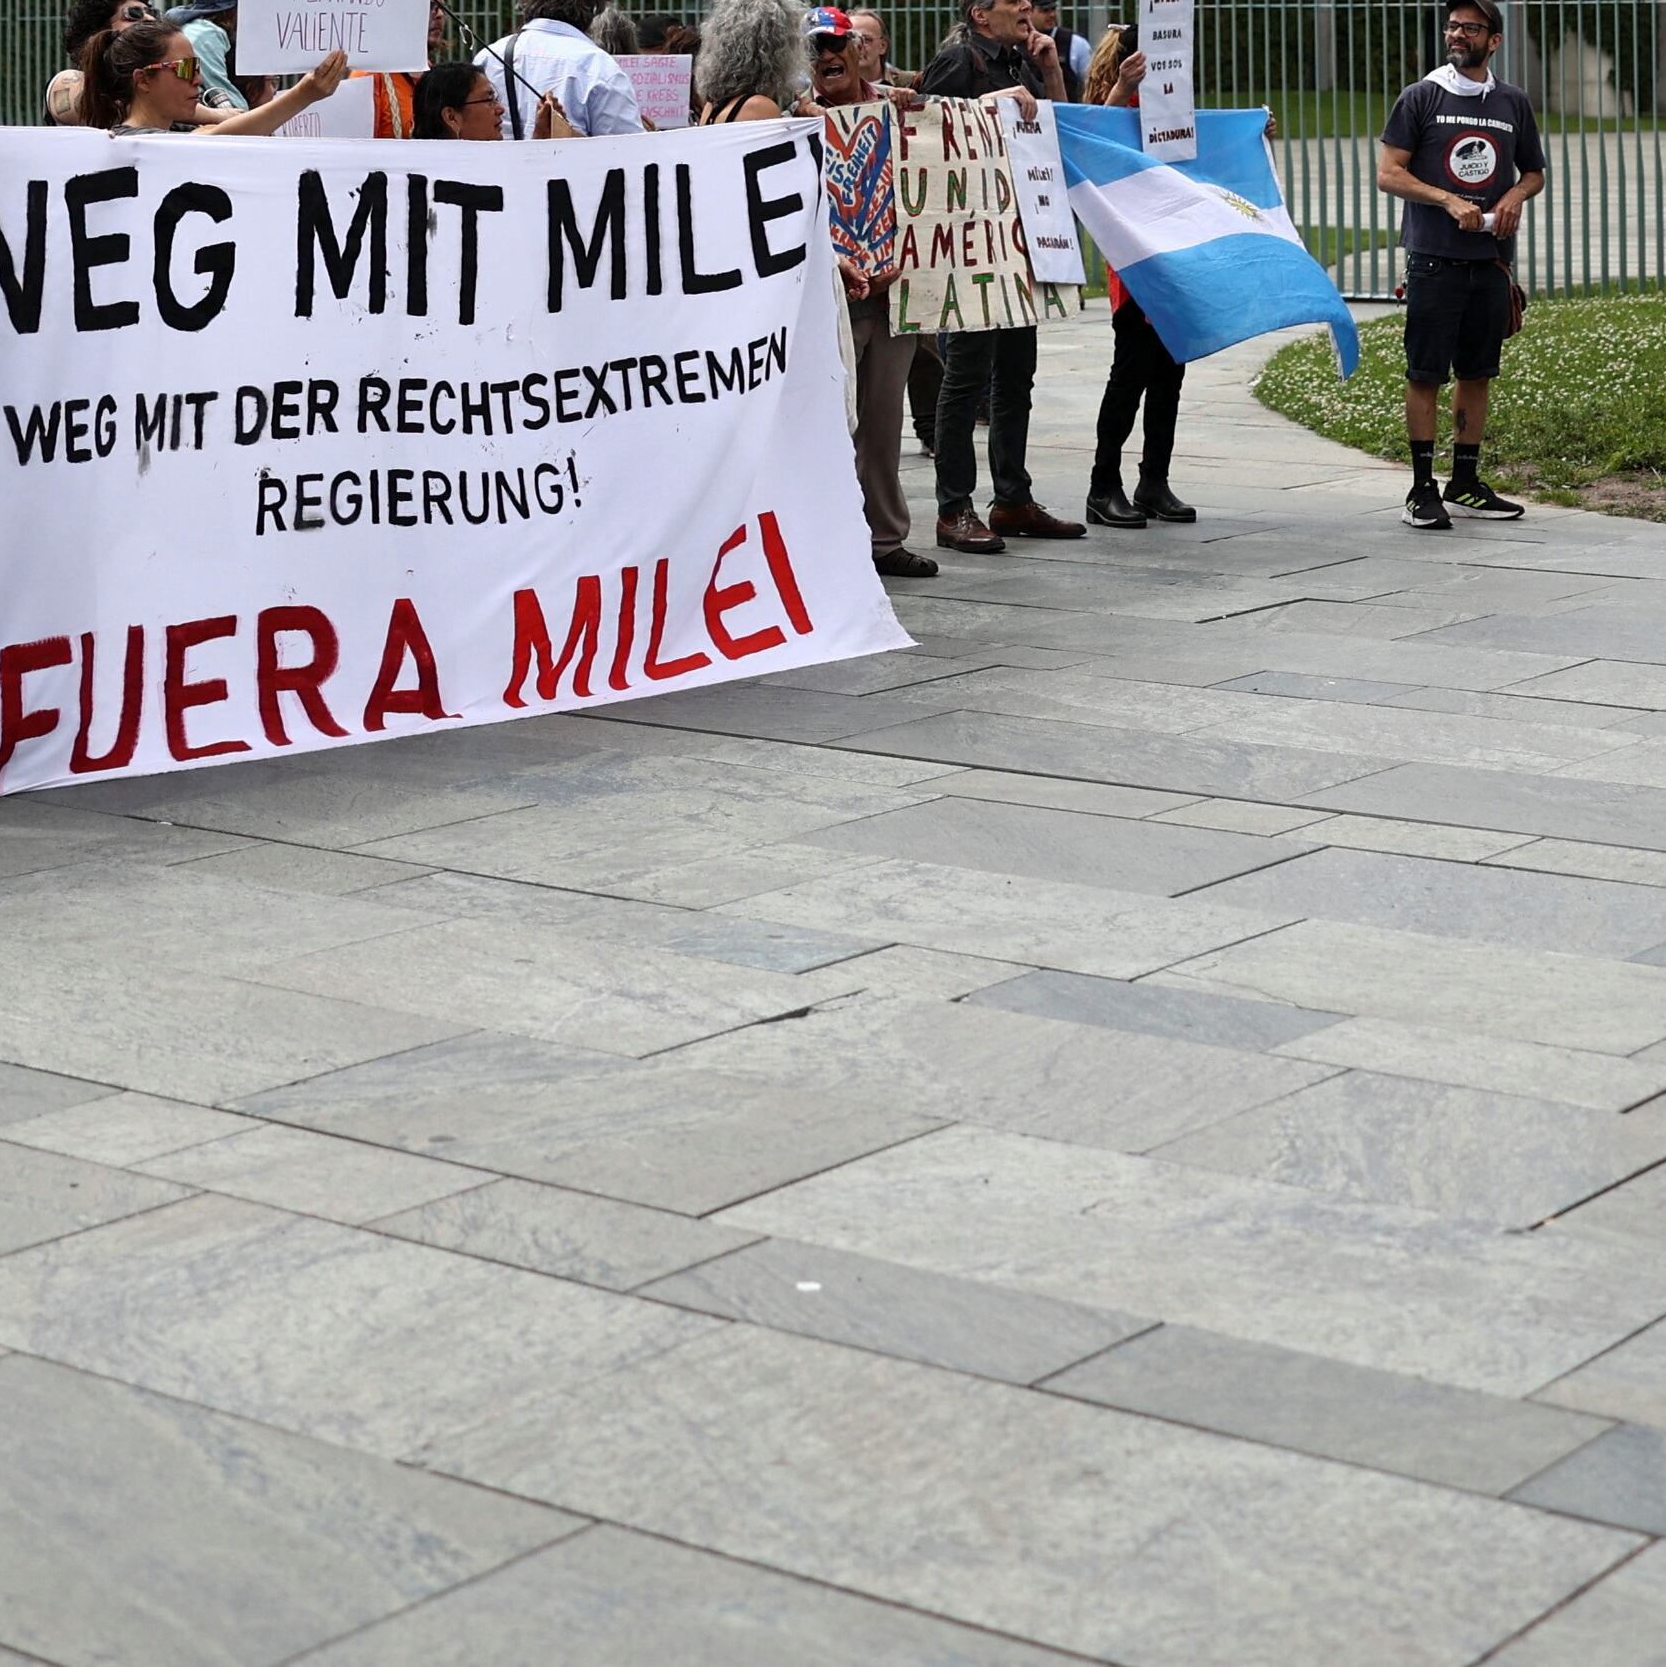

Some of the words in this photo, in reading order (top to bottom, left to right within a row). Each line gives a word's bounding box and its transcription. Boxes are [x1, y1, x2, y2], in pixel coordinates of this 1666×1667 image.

[1152, 28, 1183, 41] BASURA
[1151, 60, 1167, 72] VOS
[1168, 58, 1183, 70] SOS
[1163, 83, 1174, 95] LA
[647, 88, 678, 101] KREBS
[898, 101, 1005, 162] FRENT
[1436, 115, 1445, 124] YO
[1446, 115, 1456, 124] ME
[1457, 116, 1478, 126] PONGO
[1479, 118, 1487, 127] LA
[1487, 118, 1513, 133] CAMISETA
[842, 123, 879, 206] FREIHEIT
[1458, 169, 1490, 178] CASTIGO
[900, 167, 1011, 217] UNID
[294, 170, 504, 326] MIT
[899, 273, 1068, 332] LATINA
[1, 393, 119, 467] WEG
[133, 390, 219, 454] MIT
[234, 377, 339, 446] DER
[355, 326, 788, 436] RECHTSEXTREMEN
[255, 456, 583, 536] REGIERUNG!
[502, 509, 814, 709] MILEI
